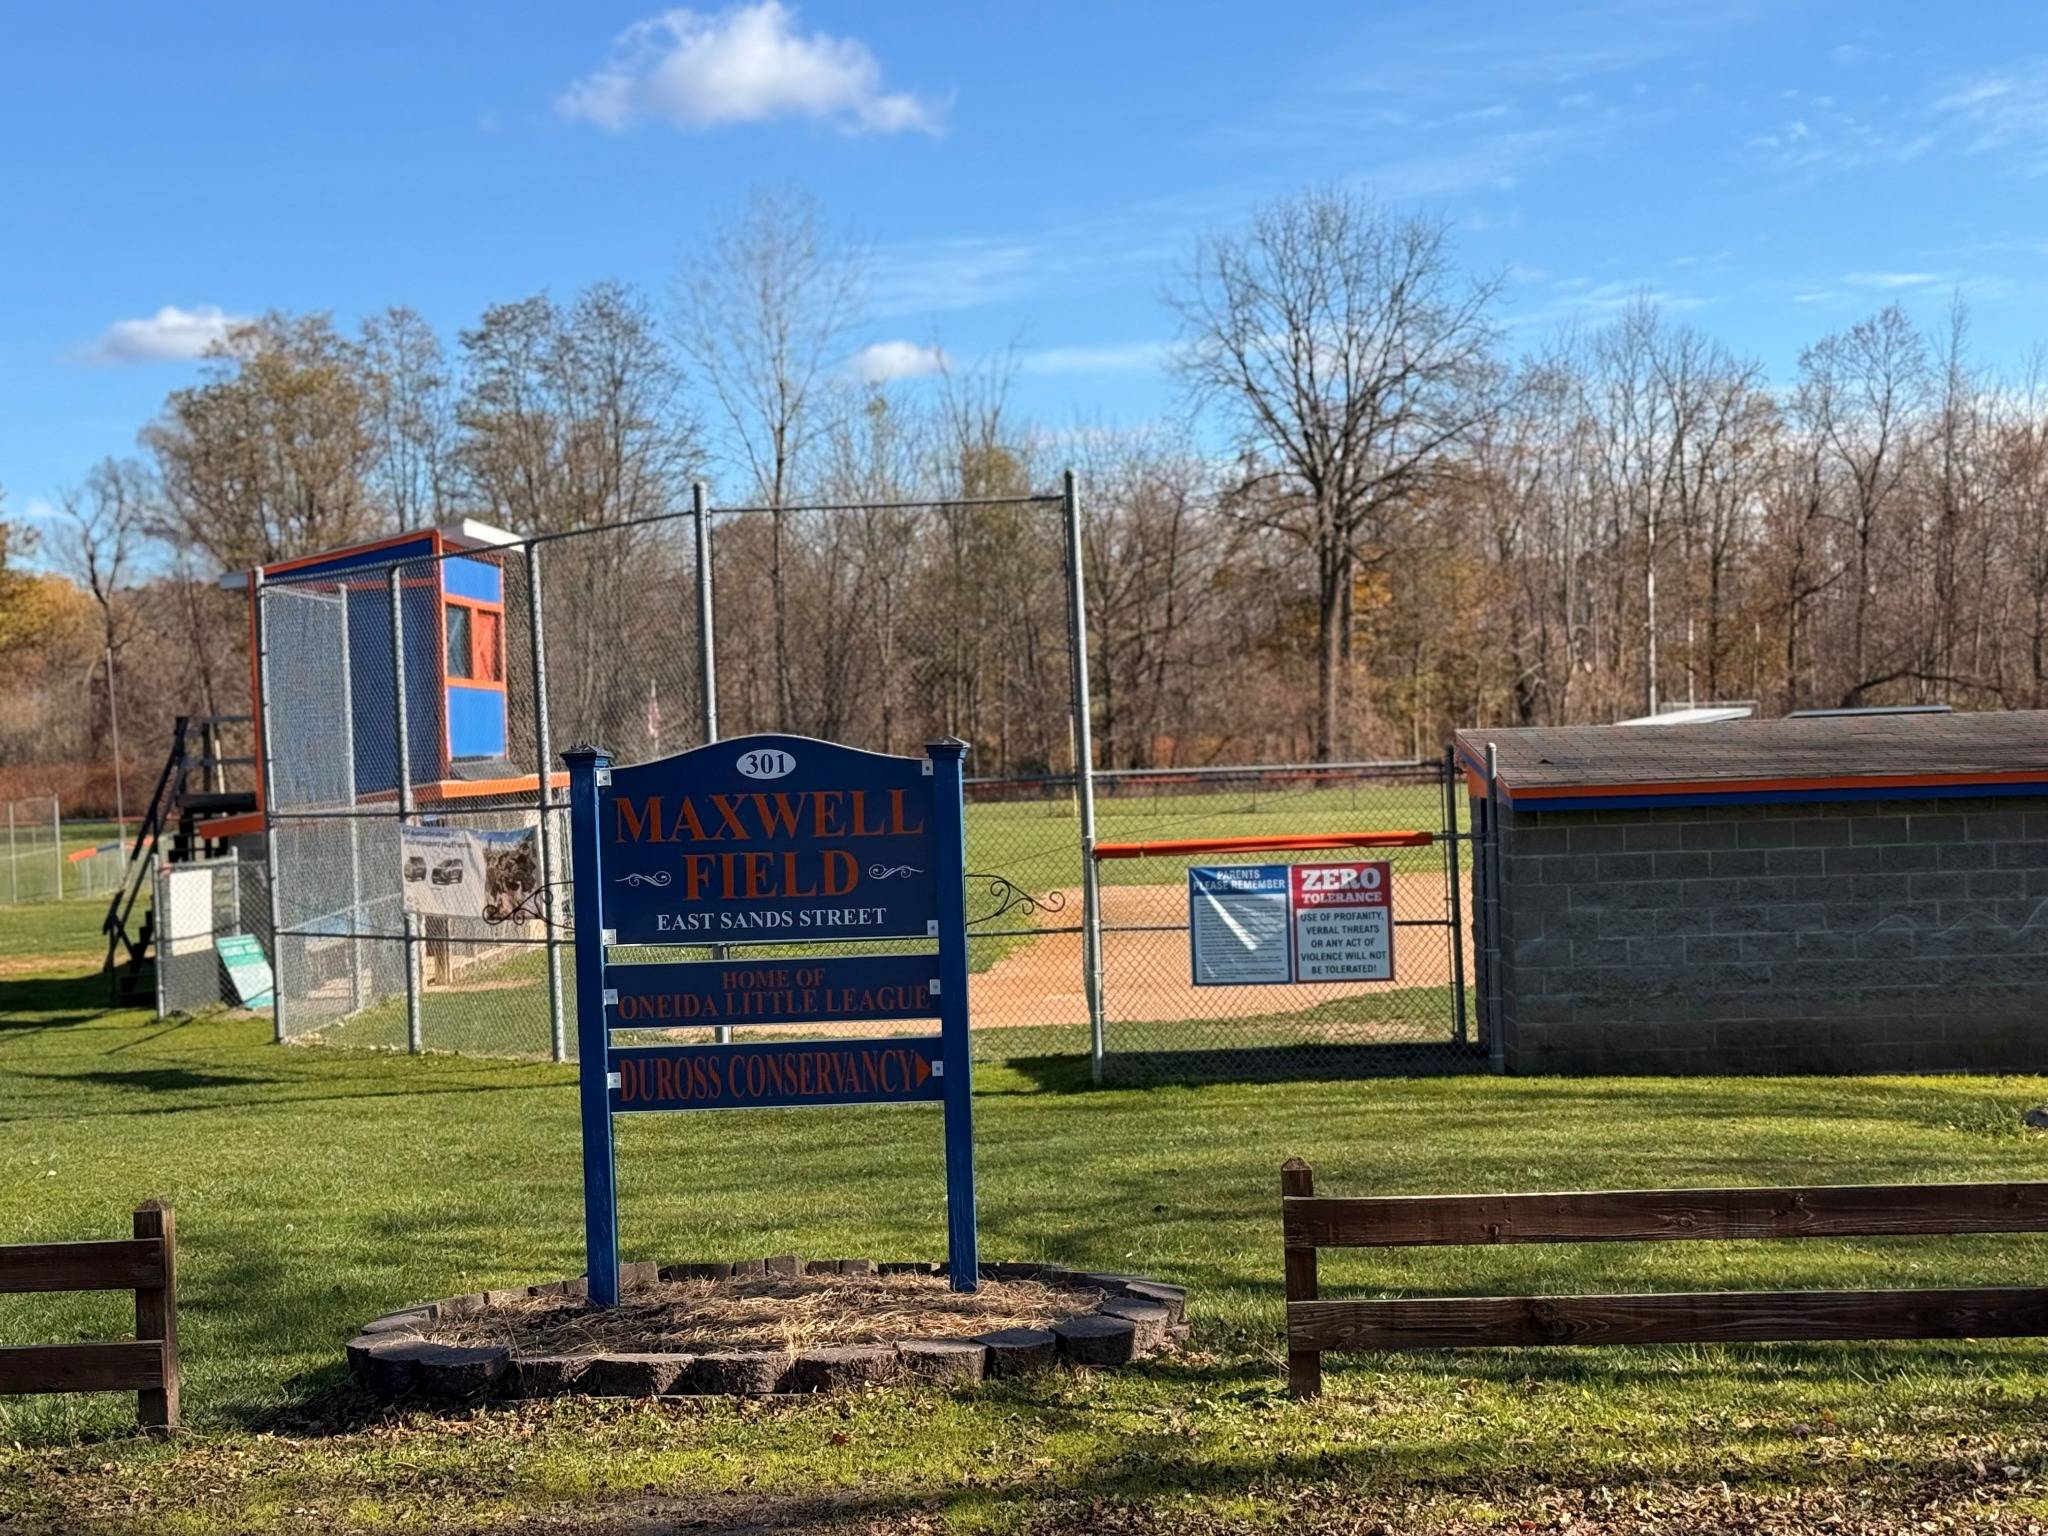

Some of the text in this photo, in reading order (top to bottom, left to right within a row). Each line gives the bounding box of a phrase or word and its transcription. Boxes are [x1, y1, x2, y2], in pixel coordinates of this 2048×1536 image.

[745, 754, 787, 774] 301
[614, 789, 924, 843] MAXWELL
[683, 849, 859, 901] FIELD
[1216, 869, 1260, 879] PARENTS
[1302, 868, 1381, 891] ZERO
[1193, 879, 1285, 891] PLEASE REMEMBER
[1302, 892, 1382, 904] TOLERANCE
[656, 908, 886, 931] EAST SANDS STREET
[1300, 913, 1317, 922] USE
[1320, 913, 1331, 921] OF
[1306, 925, 1379, 935] VERBAL THREATS
[1311, 938, 1375, 948] OR ANY ACT OF
[1301, 951, 1386, 961] VIOLENCE WILL NOT
[1311, 965, 1376, 974] BE TOLERATED!
[722, 968, 825, 990] HOME OF
[618, 984, 931, 1020] ONEIDA LITTLE LEAGUE
[619, 1049, 917, 1103] DUROSS CONSERVANCY
